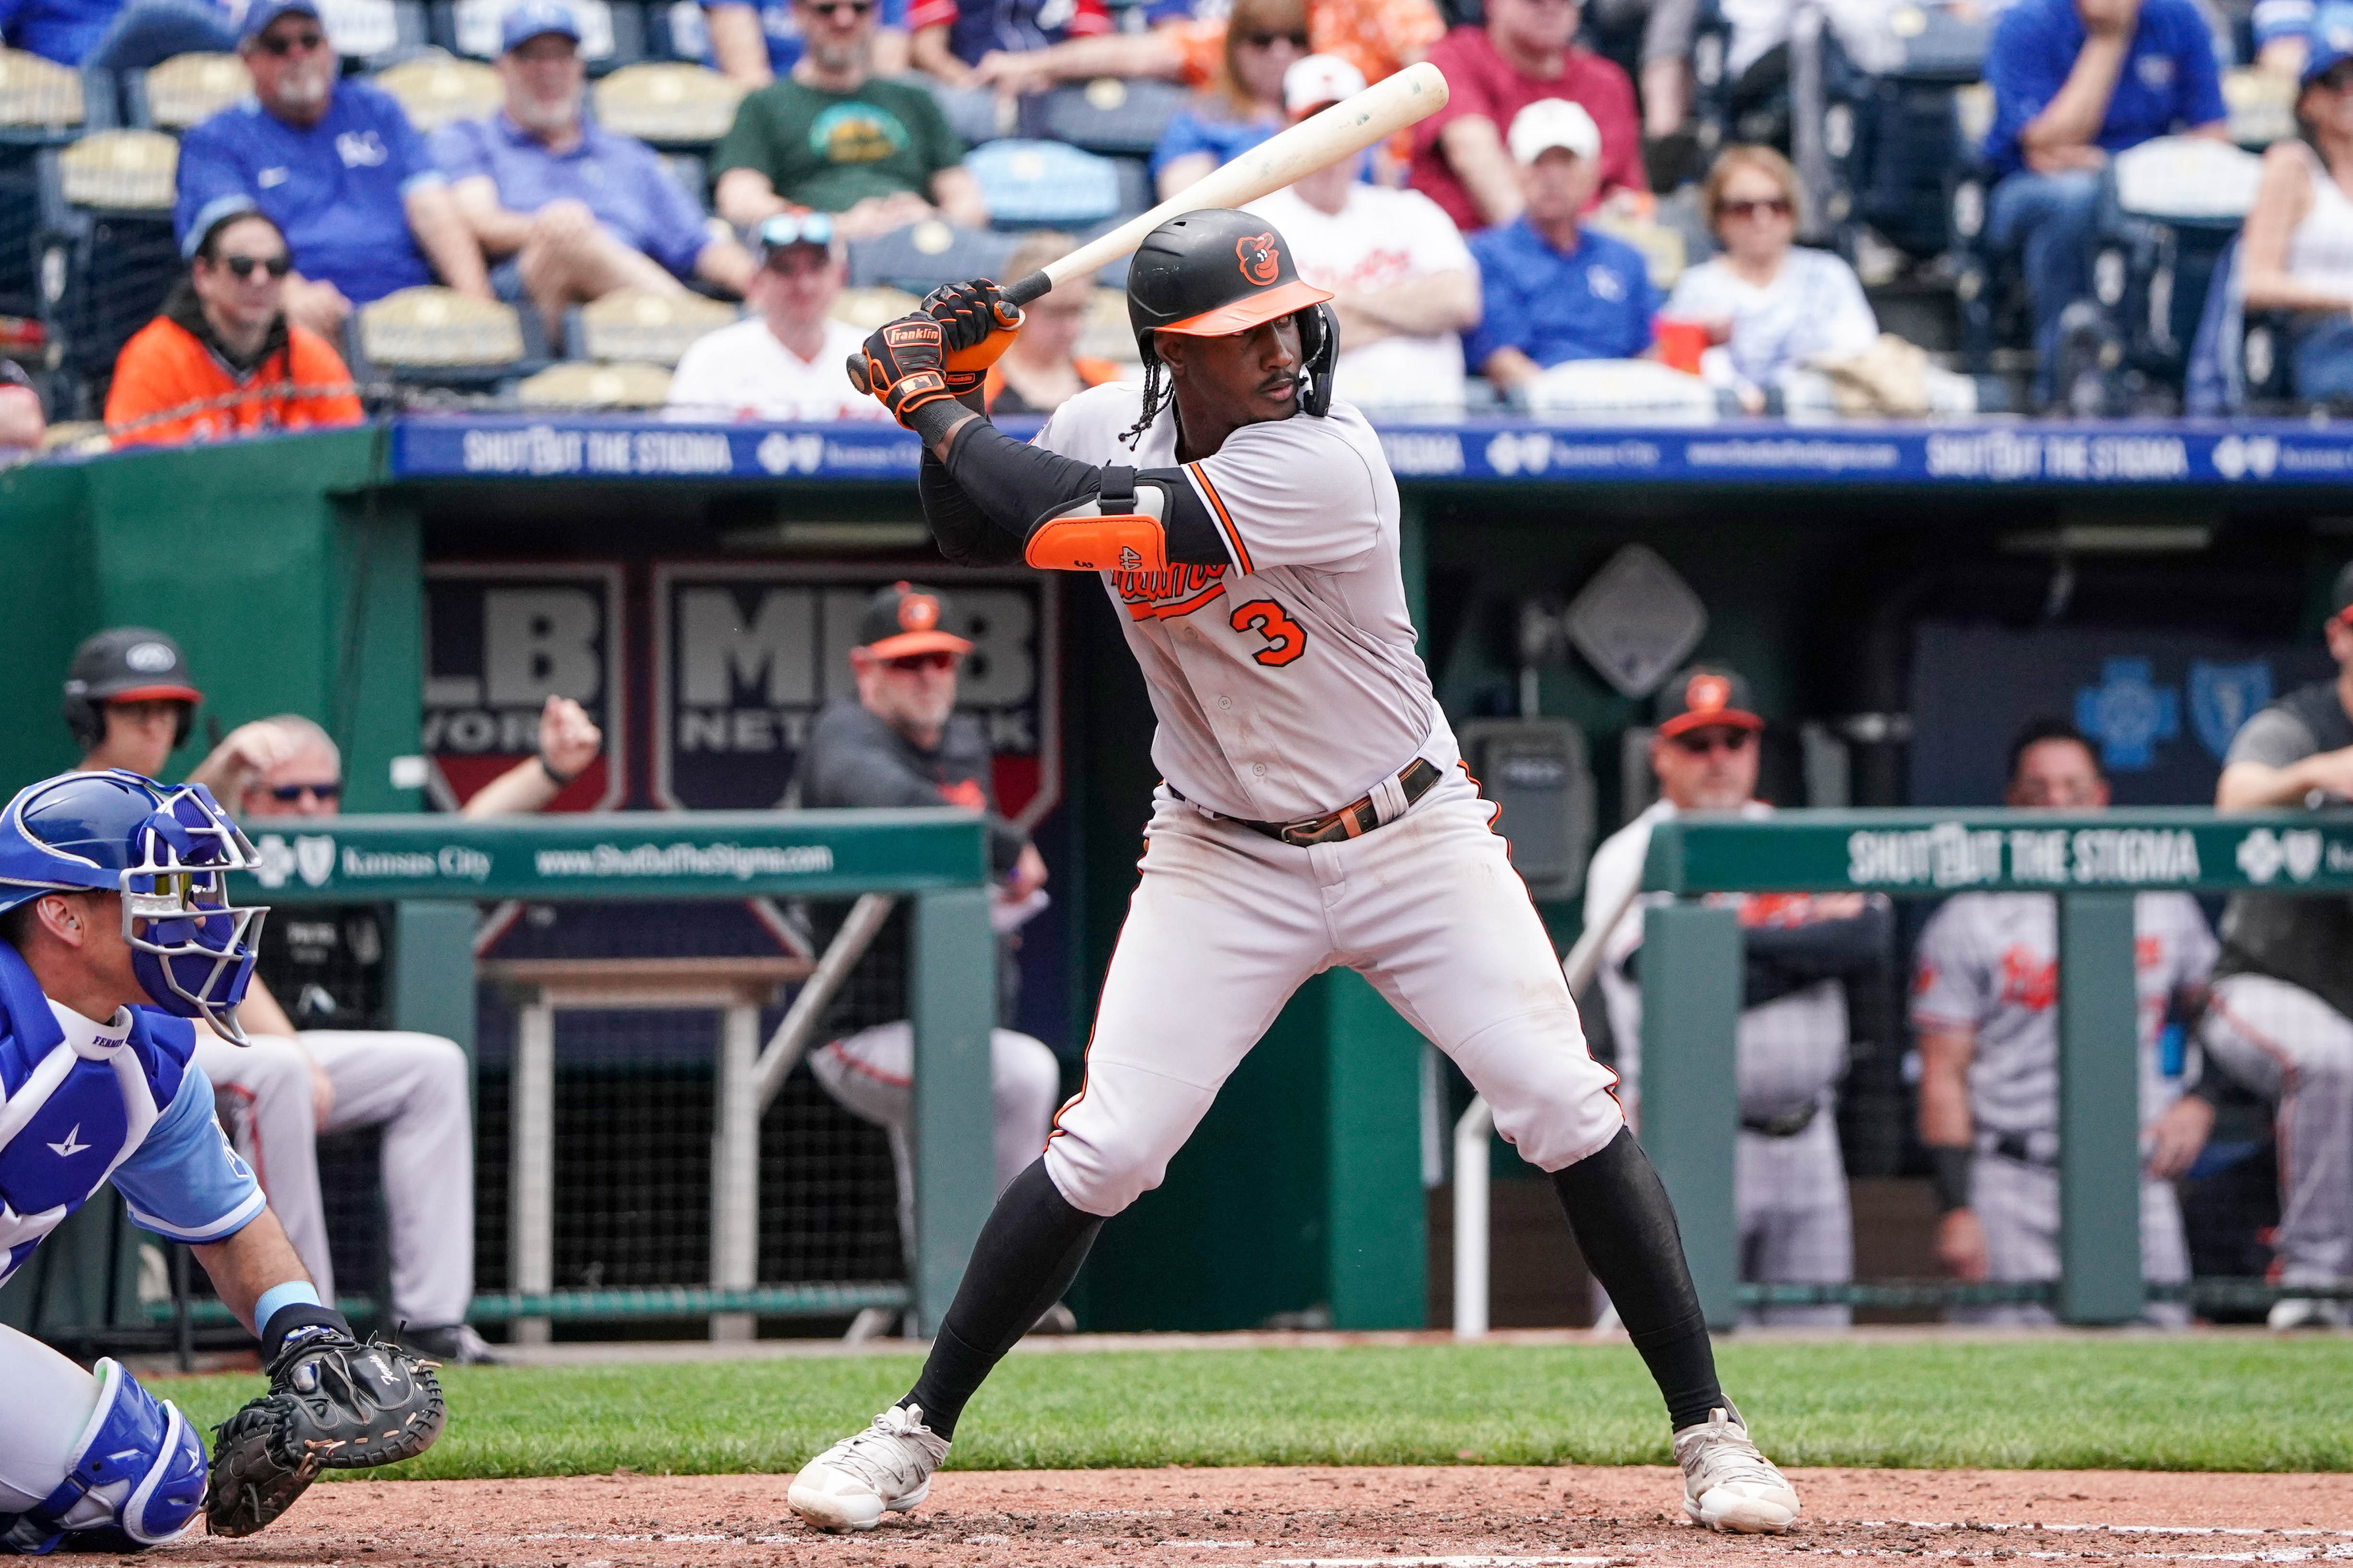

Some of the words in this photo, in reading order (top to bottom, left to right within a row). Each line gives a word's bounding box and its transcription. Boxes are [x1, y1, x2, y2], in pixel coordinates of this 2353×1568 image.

[890, 328, 938, 344] Franklin
[1229, 599, 1308, 667] 3
[342, 845, 436, 879] Kansas
[437, 844, 492, 884] City
[2011, 830, 2067, 883] THE
[2071, 829, 2201, 884] STIGMA
